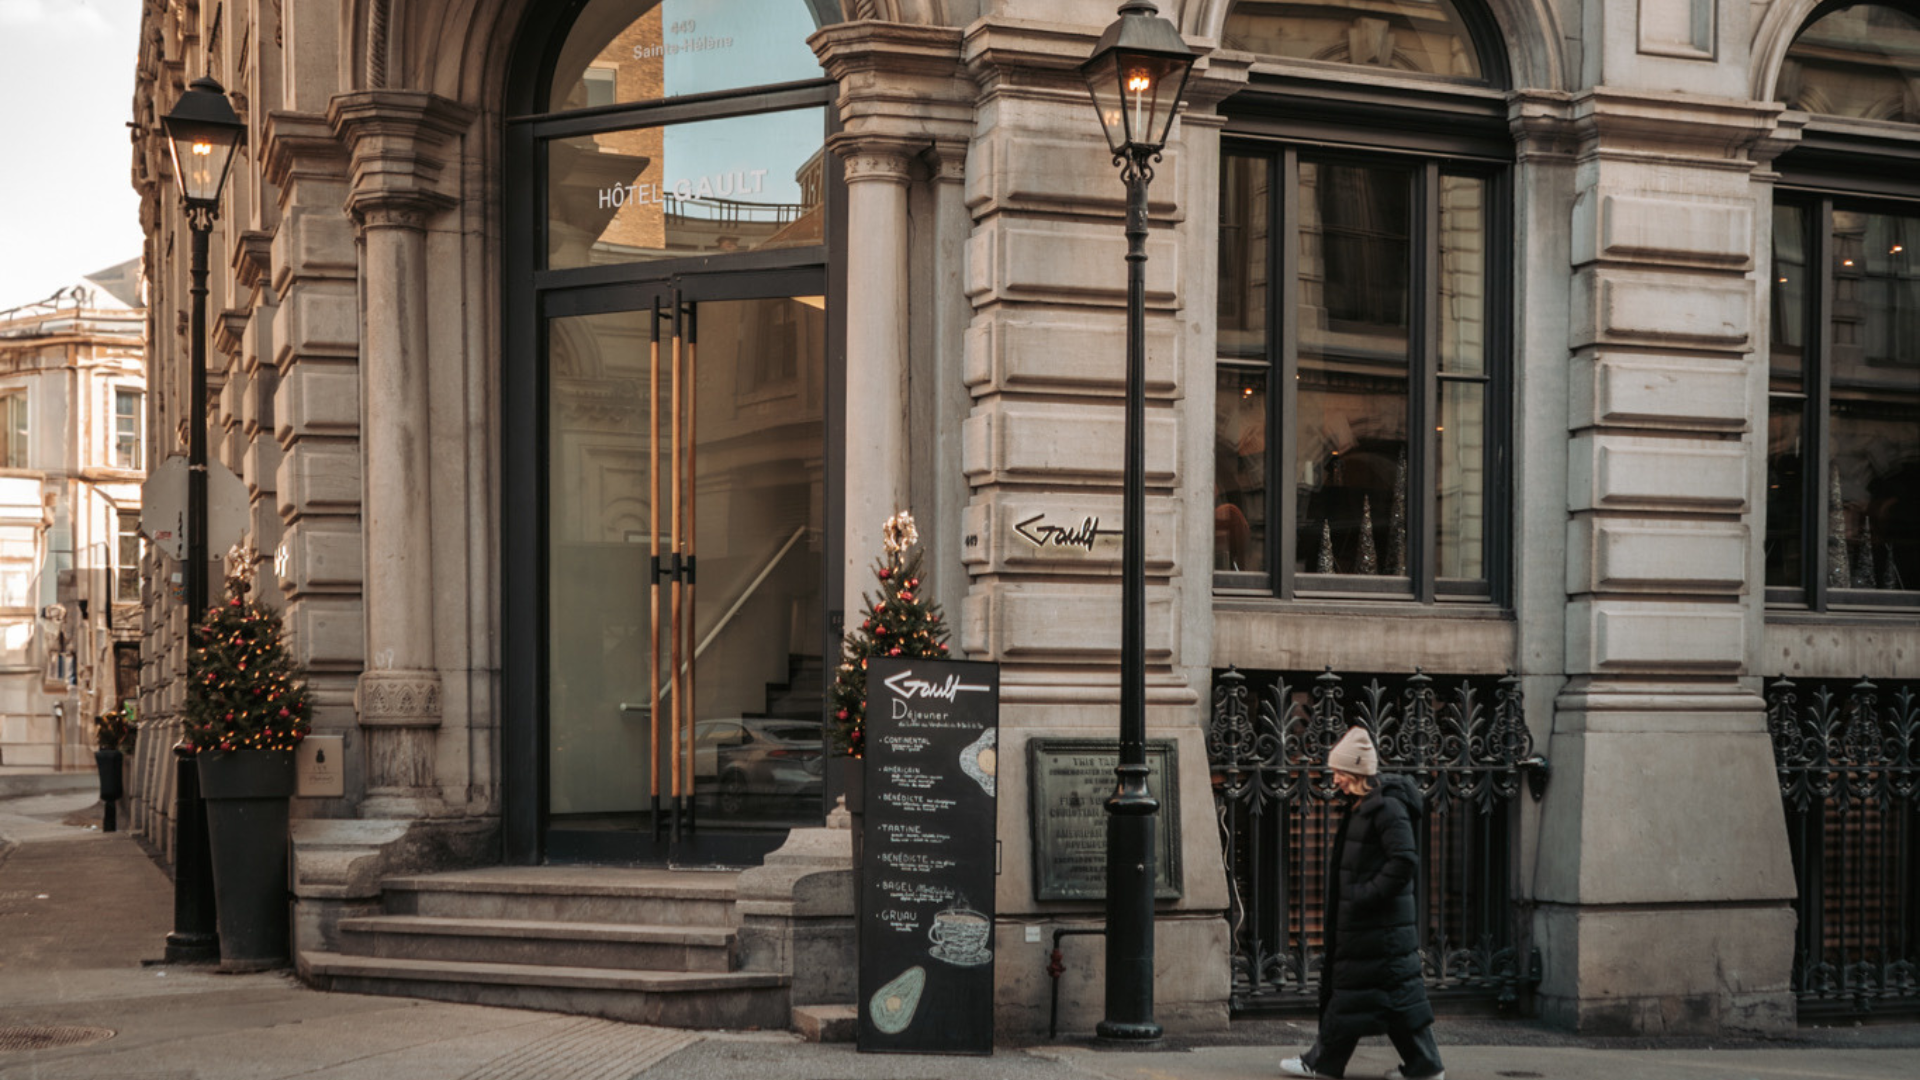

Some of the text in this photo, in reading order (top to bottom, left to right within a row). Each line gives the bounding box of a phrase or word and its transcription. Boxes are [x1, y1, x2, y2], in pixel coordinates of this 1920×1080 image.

[670, 19, 696, 35] 449
[632, 35, 733, 60] Sainte-Hélène
[598, 168, 768, 209] HÔTEL GAULT
[1013, 513, 1123, 552] Gault
[884, 669, 991, 703] Gault
[892, 698, 949, 723] Déjeuner
[881, 823, 921, 834] TARTINE
[882, 881, 913, 892] BAGEL
[882, 909, 917, 921] GRUAU
